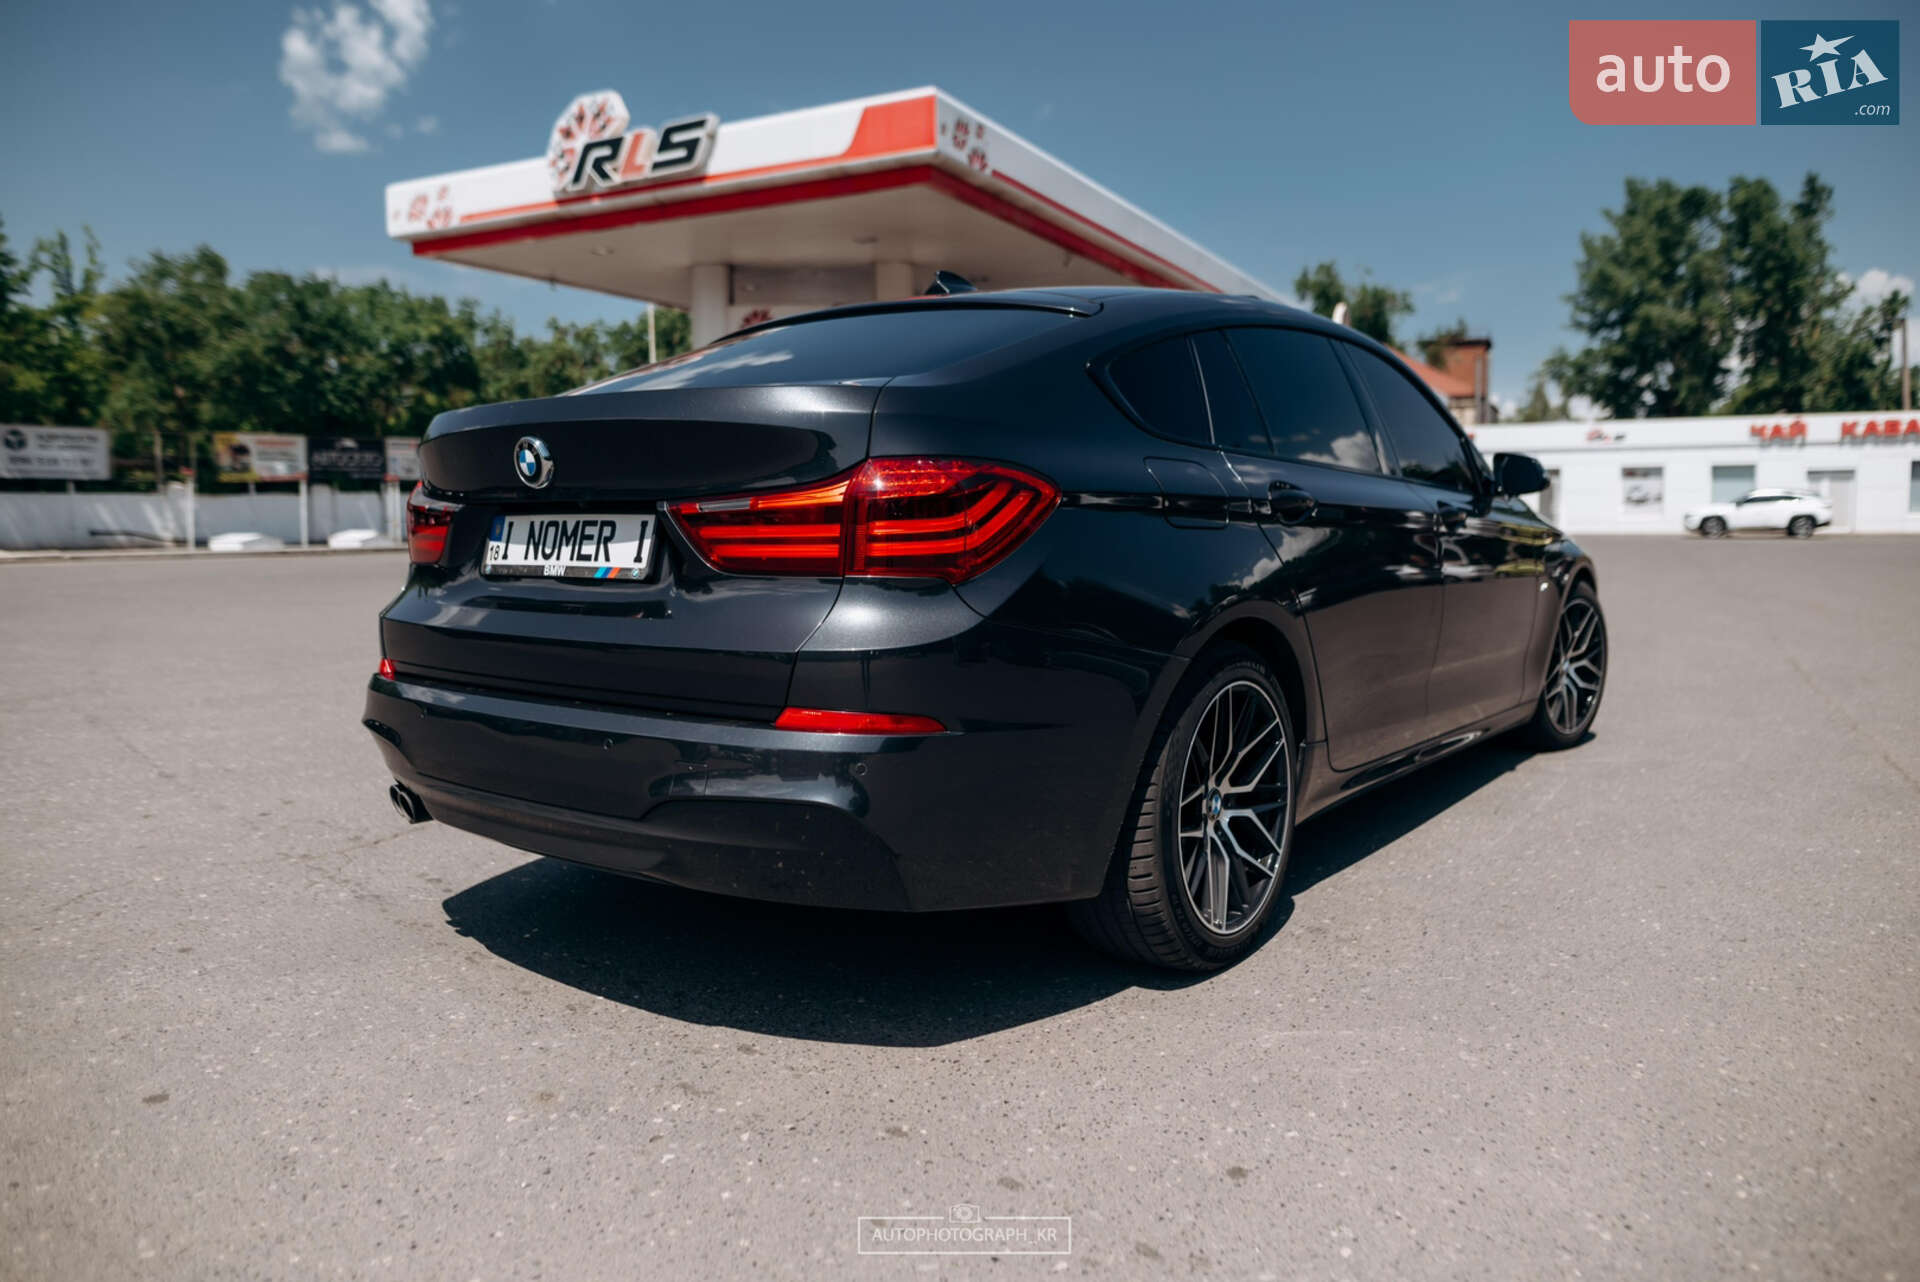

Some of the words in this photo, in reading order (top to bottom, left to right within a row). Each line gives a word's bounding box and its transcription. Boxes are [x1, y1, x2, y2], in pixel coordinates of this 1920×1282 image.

[572, 120, 708, 185] RLS
[1751, 416, 1806, 439] ЧАЙ
[524, 520, 617, 563] NOMER
[487, 545, 502, 562] 18
[543, 565, 567, 577] BMW
